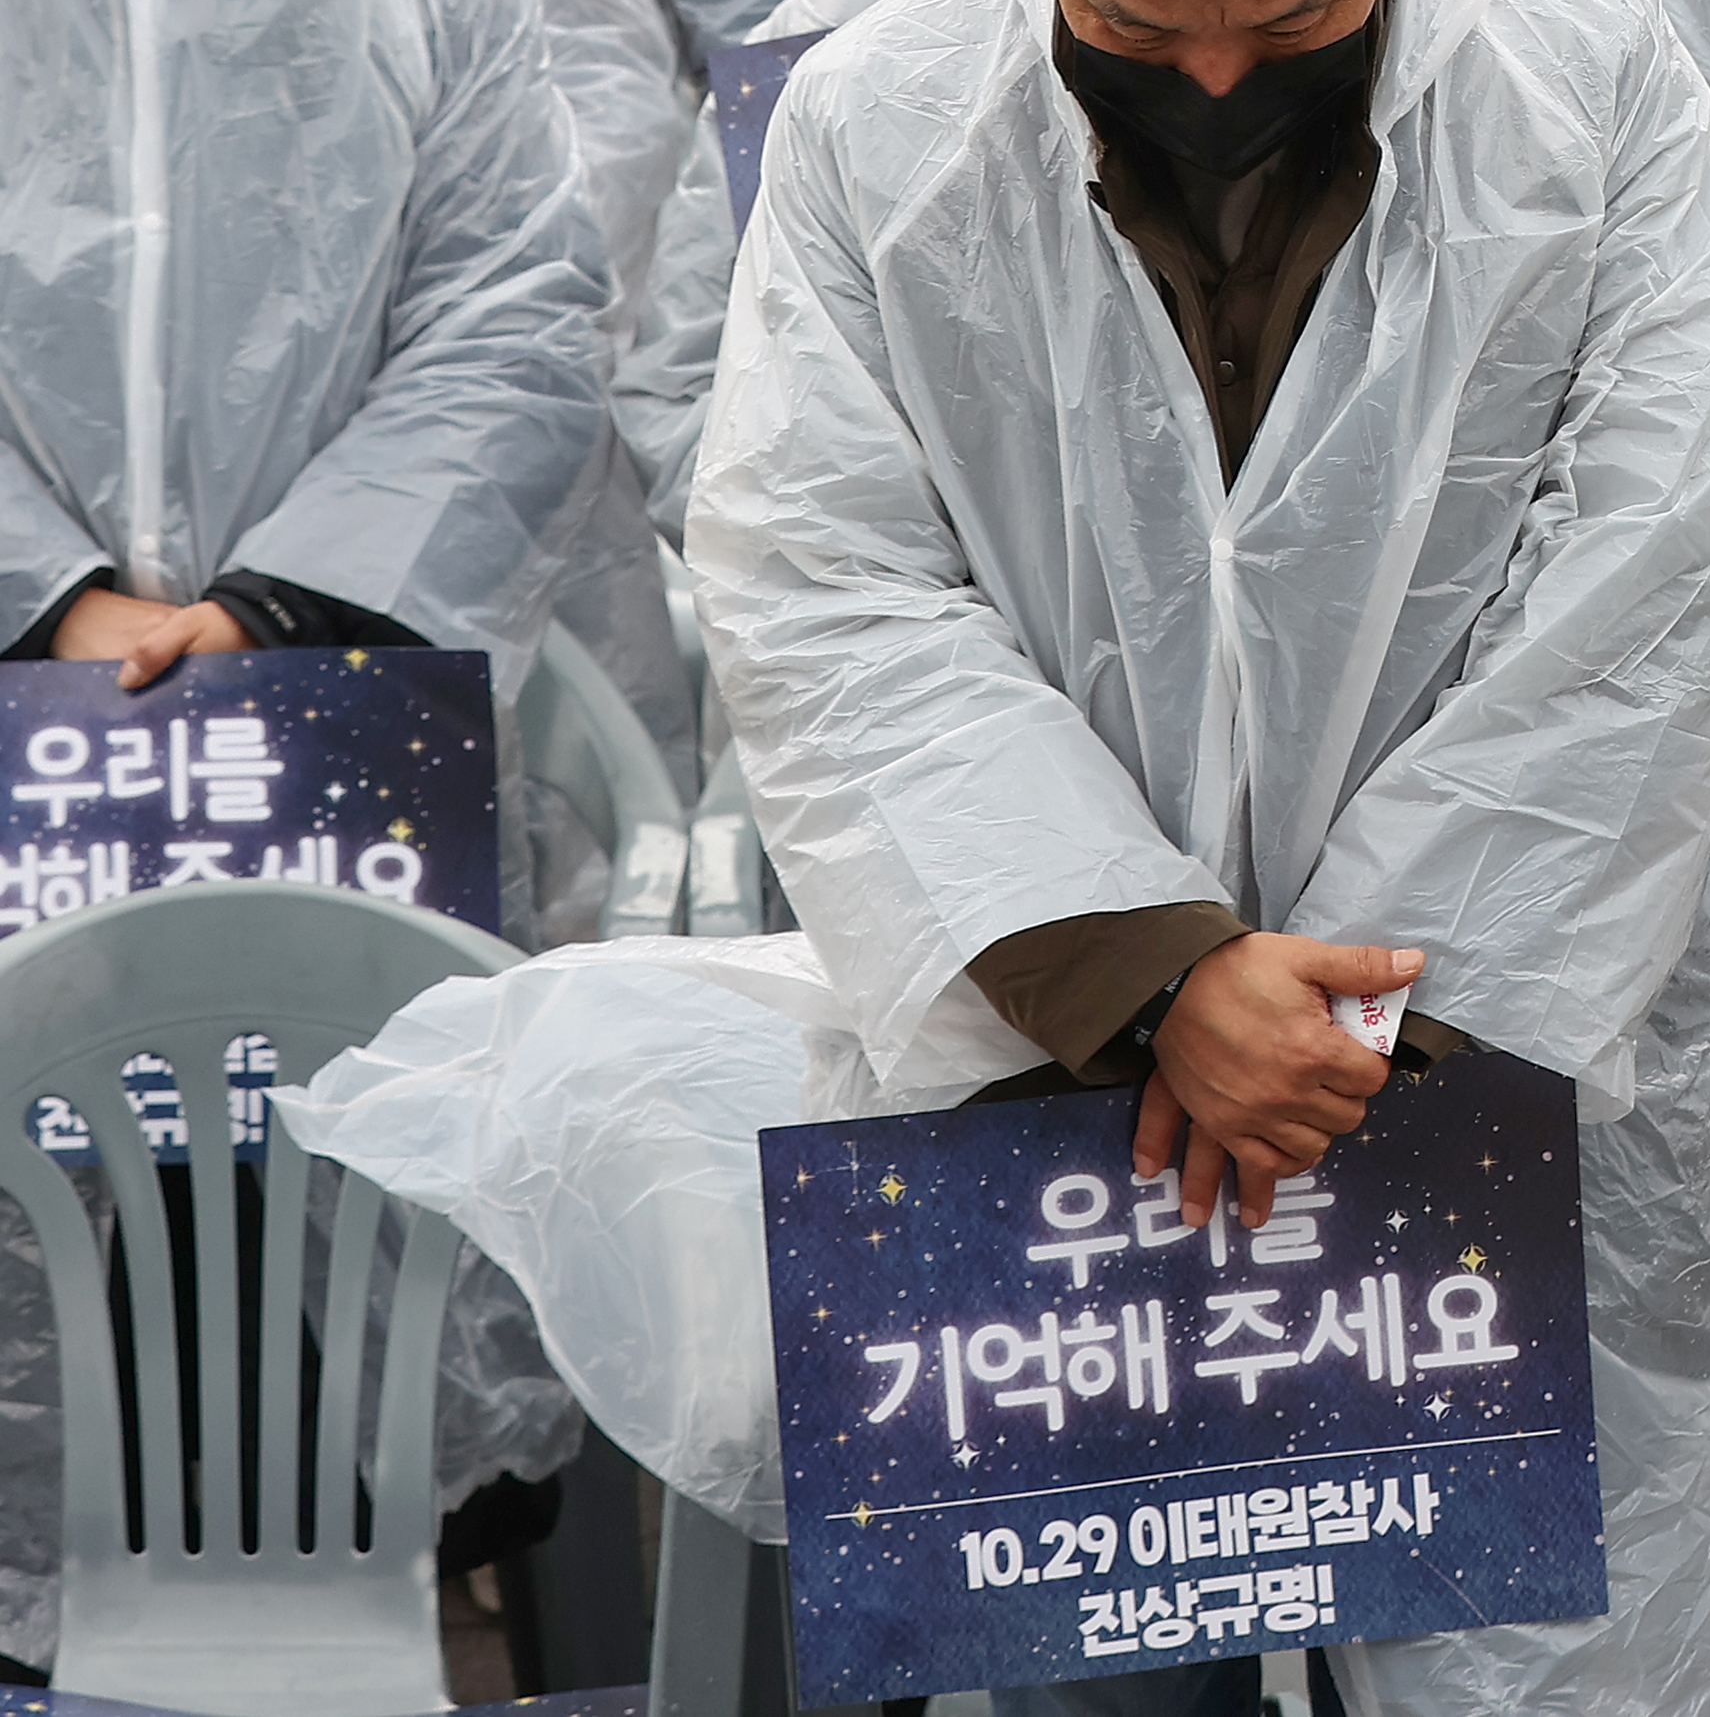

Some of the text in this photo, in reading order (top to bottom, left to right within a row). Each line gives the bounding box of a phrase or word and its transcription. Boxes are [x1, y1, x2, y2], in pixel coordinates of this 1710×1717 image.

[11, 718, 285, 828] 우리를
[1026, 1167, 1336, 1288] 우리를
[863, 1272, 1520, 1442] 기억해 주세요
[957, 1472, 1441, 1590] 10.29 이태원참사
[1077, 1562, 1336, 1658] 진상규명!
